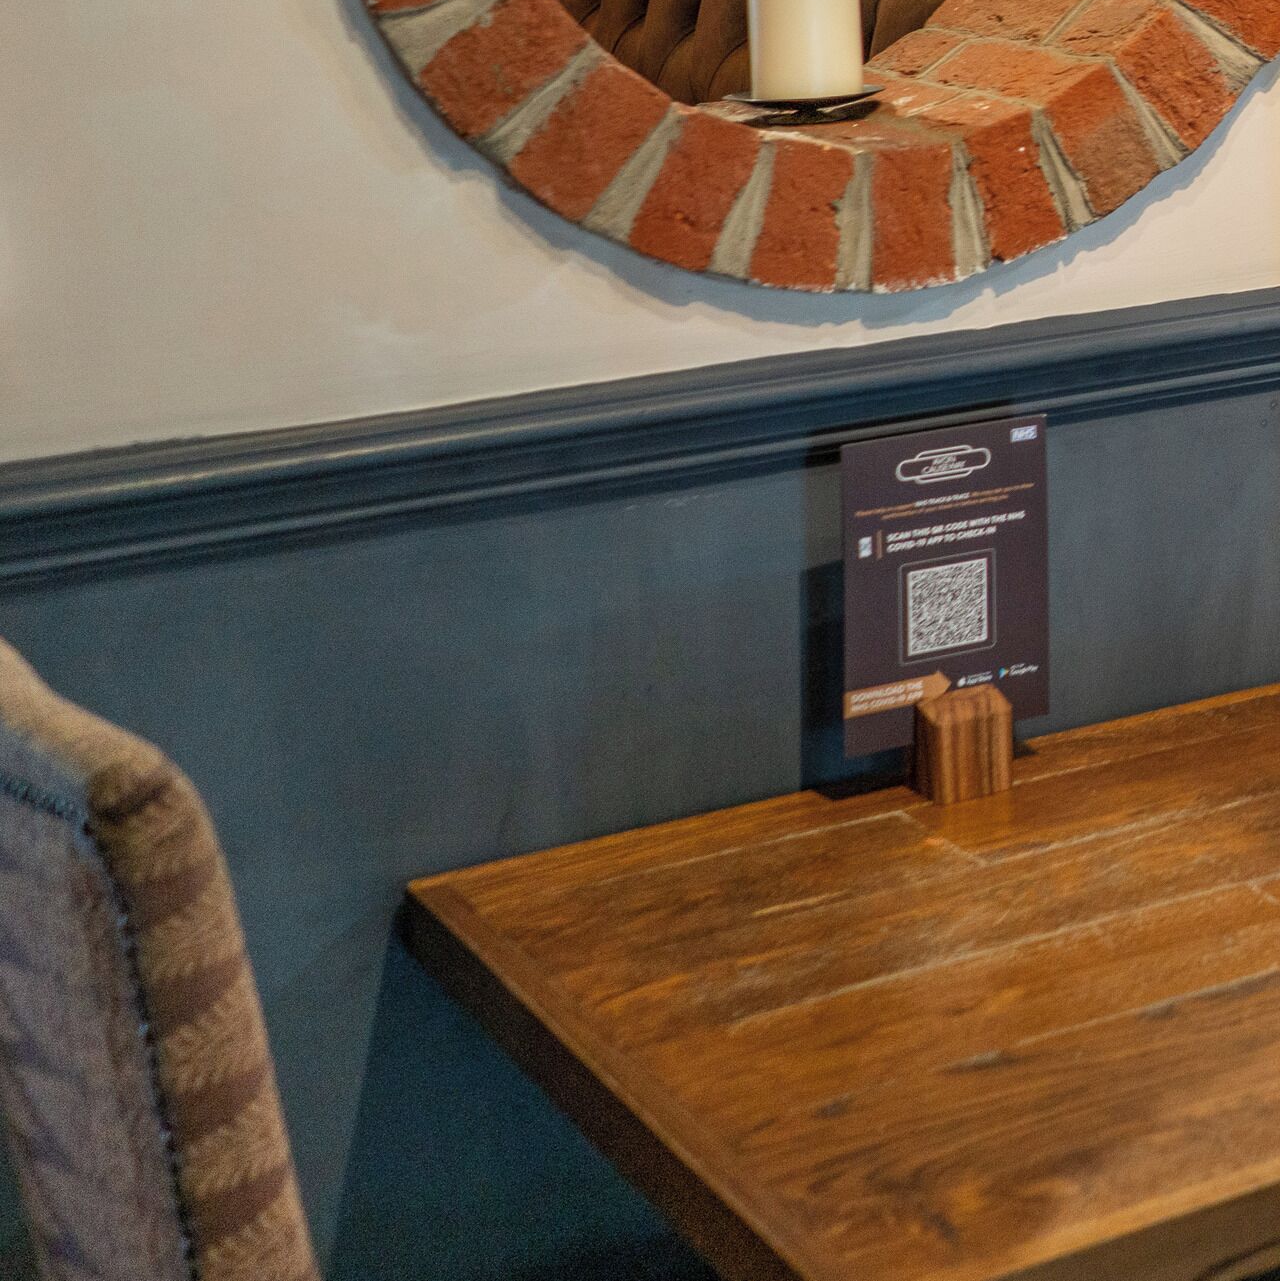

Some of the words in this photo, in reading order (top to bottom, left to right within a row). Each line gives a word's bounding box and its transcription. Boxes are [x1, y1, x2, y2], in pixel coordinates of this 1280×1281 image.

[886, 531, 912, 543] SCAN
[911, 527, 932, 538] THIS
[931, 524, 944, 536] QR
[944, 520, 969, 533] CODE
[968, 516, 991, 528] WITH
[991, 513, 1008, 524] THE
[1007, 510, 1026, 521] NHS
[886, 537, 926, 554] COVID-19
[926, 534, 944, 546] APP
[944, 532, 957, 543] TO
[851, 686, 906, 703] DOWNLOAD
[906, 680, 924, 691] THE
